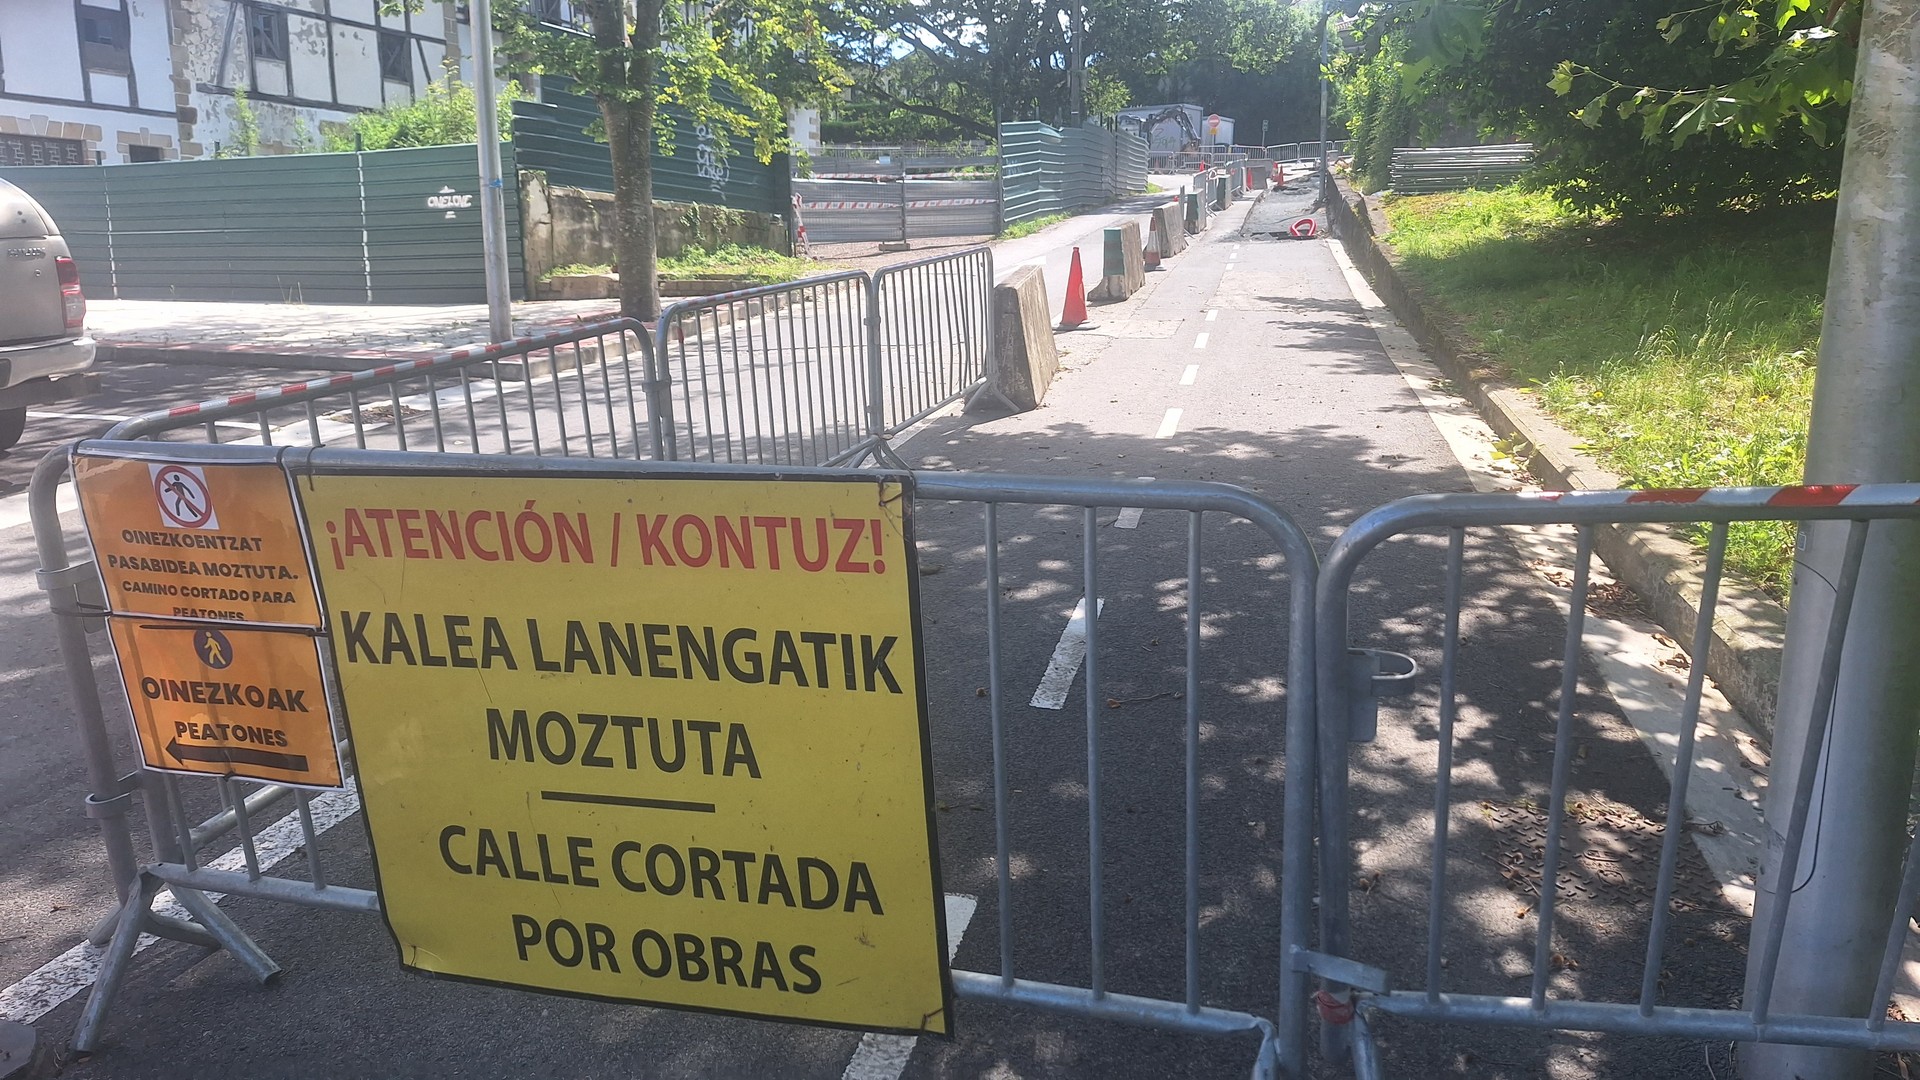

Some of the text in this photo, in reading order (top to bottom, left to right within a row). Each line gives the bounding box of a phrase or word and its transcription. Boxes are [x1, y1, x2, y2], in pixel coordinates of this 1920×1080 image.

[122, 529, 262, 551] OINEZKOENTZAT
[325, 500, 885, 574] ¡ATENCIÓN / KONTUZ!
[107, 554, 299, 580] PASABIDEA MOZTUTA.
[122, 580, 296, 603] CAMINO CORTADO PARA
[340, 610, 903, 695] KALEA LANENGATIK
[141, 676, 309, 713] OINEZKOAK
[174, 720, 289, 748] PEATONES
[486, 708, 762, 779] MOZTUTA
[439, 824, 885, 916] CALLE CORTADA
[511, 914, 823, 995] POR OBRAS
